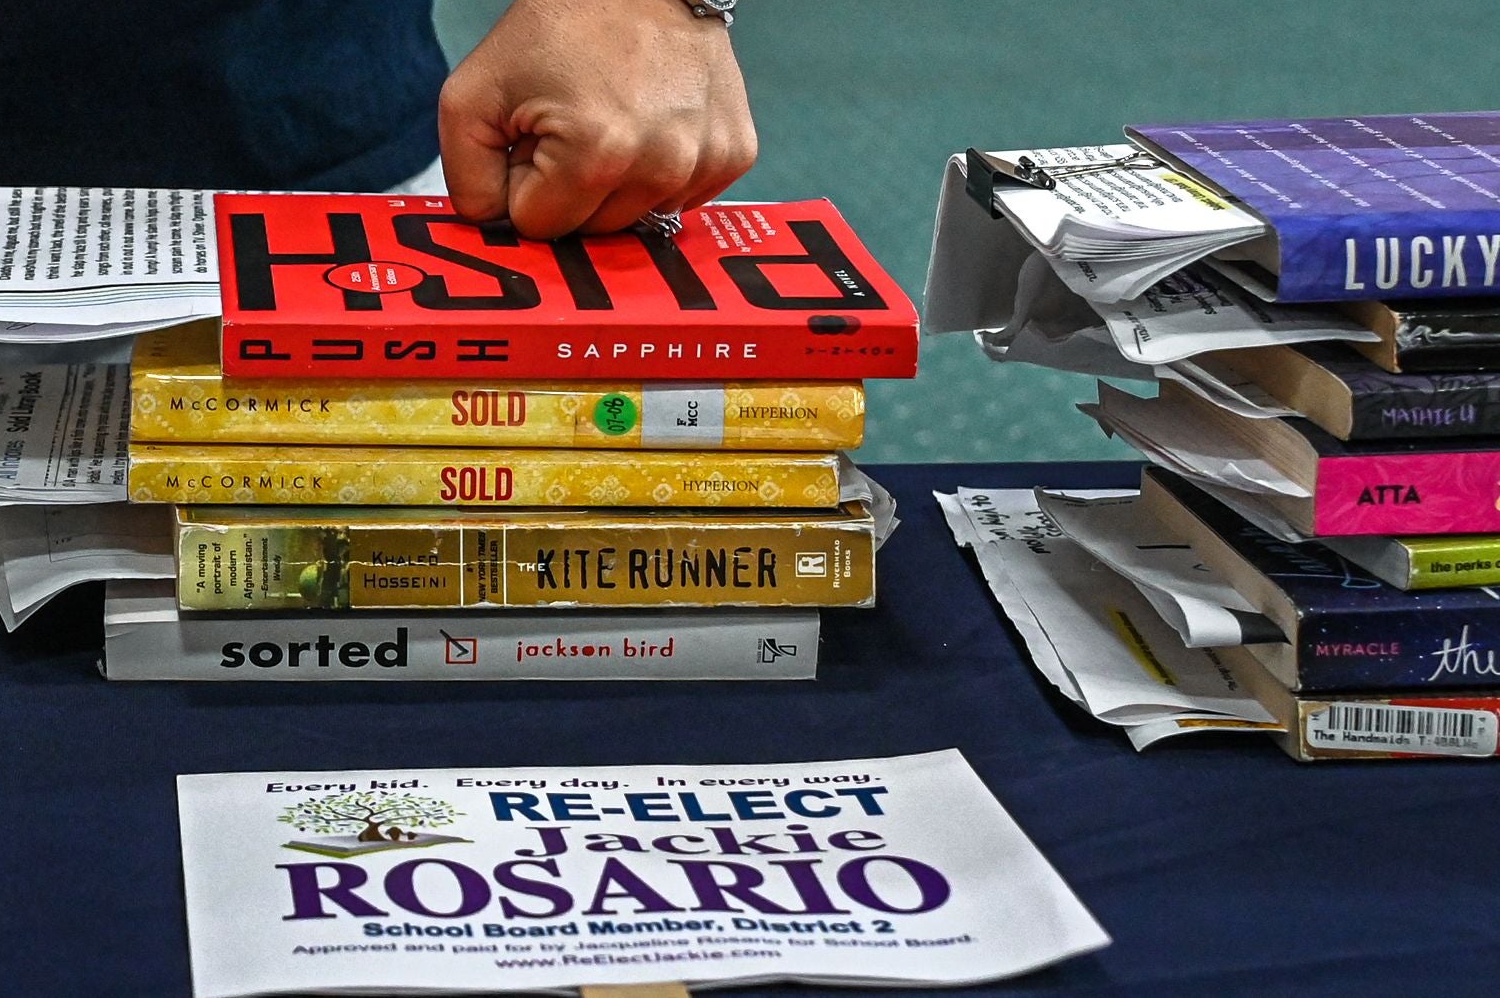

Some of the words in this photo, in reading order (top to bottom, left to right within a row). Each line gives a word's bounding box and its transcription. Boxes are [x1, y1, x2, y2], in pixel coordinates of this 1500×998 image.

[1345, 235, 1500, 290] LUCKY
[834, 269, 859, 290] NOVEL
[557, 343, 757, 358] SAPPHIRE
[170, 397, 331, 412] McCORMICK
[451, 390, 526, 427] SOLD
[688, 400, 698, 427] MCC
[739, 406, 818, 419] HYPERION
[677, 417, 687, 426] F
[166, 476, 322, 489] McCORMICK
[440, 467, 513, 501] SOLD
[683, 479, 759, 492] HYPERION
[1357, 485, 1421, 506] ATTA
[212, 542, 221, 556] of
[478, 531, 486, 557] TIMES
[197, 543, 207, 579] moving
[229, 549, 237, 587] modern
[372, 551, 439, 567] KHALED
[490, 540, 498, 594] BESTSELLER
[518, 562, 546, 572] THE
[536, 549, 617, 590] KITE
[629, 547, 777, 589] RUNNER
[833, 539, 841, 589] RIVERHEAD
[1430, 562, 1451, 573] the
[1455, 559, 1492, 572] perks
[213, 560, 223, 595] portrait
[363, 573, 447, 589] HOSSEINI
[221, 628, 408, 667] sorted
[517, 638, 612, 662] jackson
[623, 637, 675, 658] bird
[1316, 642, 1400, 657] MYRACLE
[1314, 730, 1336, 742] The
[1343, 731, 1410, 746] Handmaids
[266, 781, 357, 793] Every
[365, 779, 429, 792] kid.
[456, 777, 547, 790] Every
[560, 777, 630, 790] day.
[657, 776, 688, 787] In
[699, 775, 790, 788] every
[804, 772, 882, 786] way.
[488, 786, 888, 822] RE-ELECT
[514, 824, 887, 857] Jackie
[275, 854, 951, 921] ROSARIO
[363, 921, 473, 938] School
[484, 920, 580, 937] Board
[589, 918, 724, 936] Member,
[732, 917, 866, 934] District
[872, 919, 896, 933] 2
[292, 943, 397, 954] Approved
[404, 942, 445, 953] and
[452, 942, 499, 954] paid
[540, 943, 565, 953] by
[576, 937, 690, 950] Jacqueline
